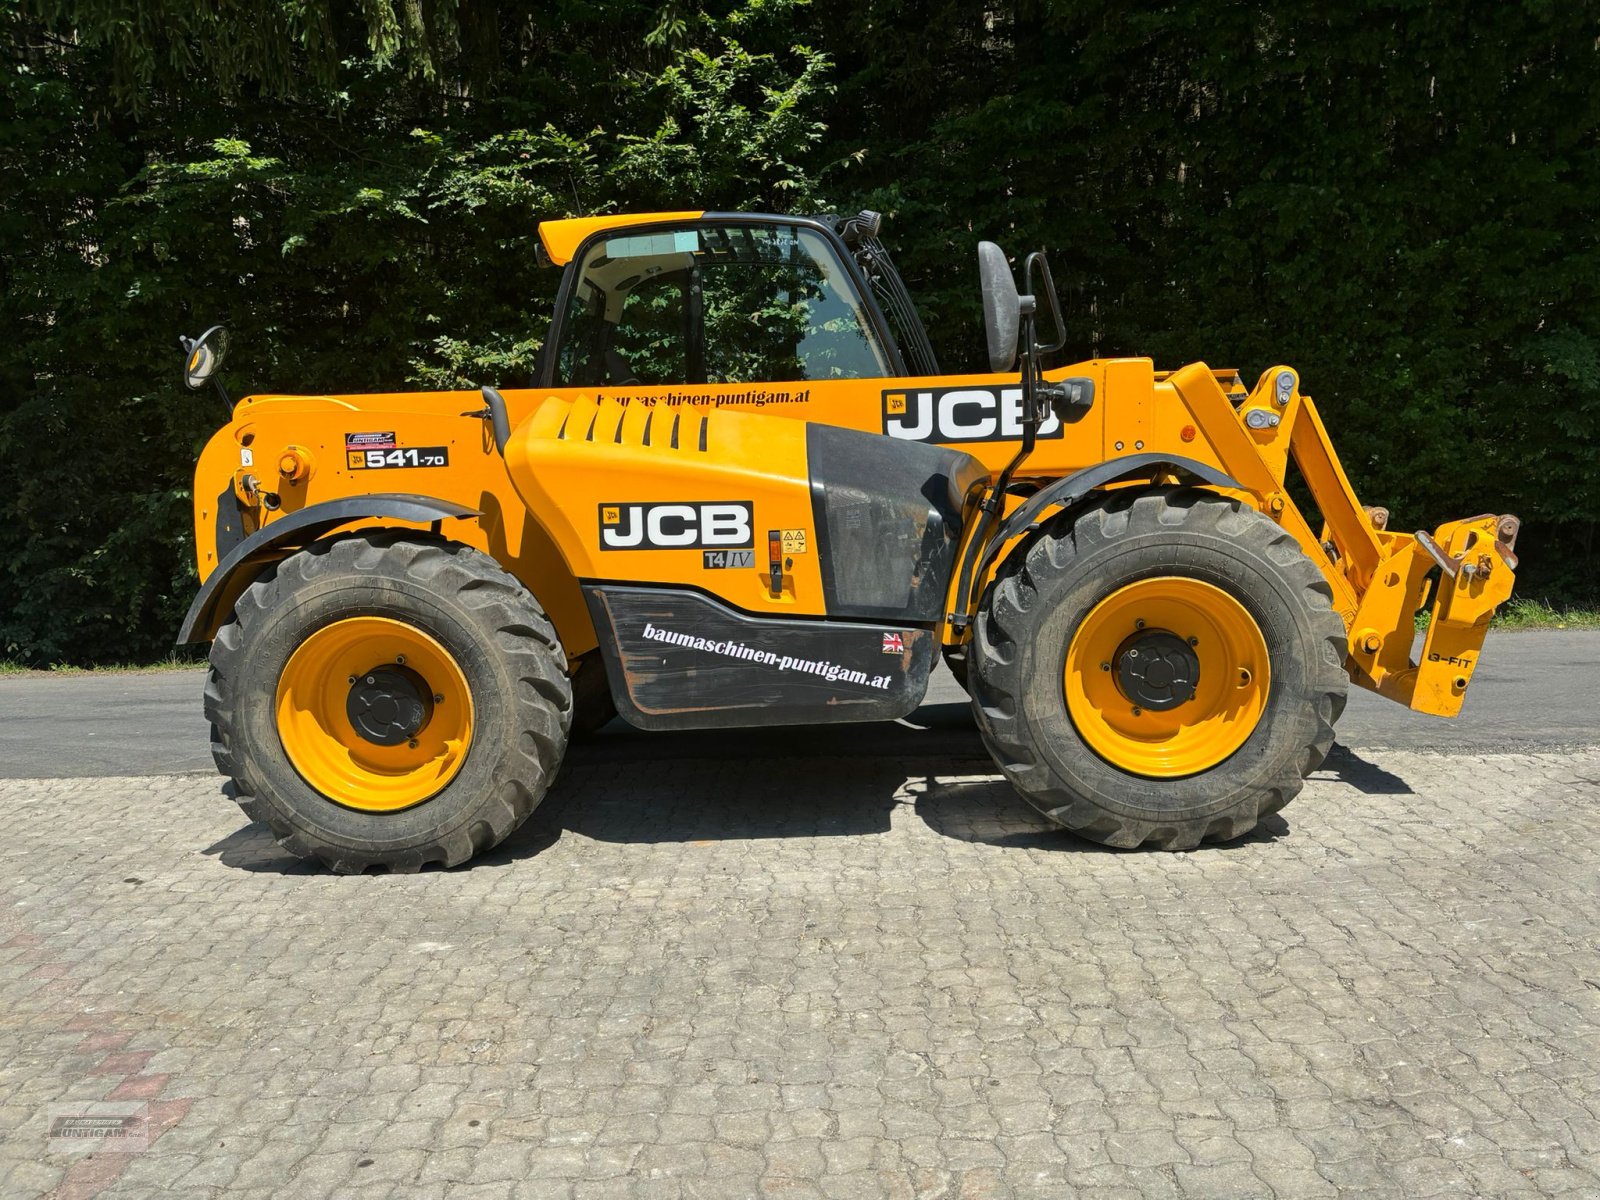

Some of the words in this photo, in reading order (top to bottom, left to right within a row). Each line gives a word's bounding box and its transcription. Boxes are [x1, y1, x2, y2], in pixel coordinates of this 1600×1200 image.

[366, 449, 445, 468] 541-70
[603, 505, 751, 547] JCB
[642, 623, 893, 690] baumaschinen-puntigam.at
